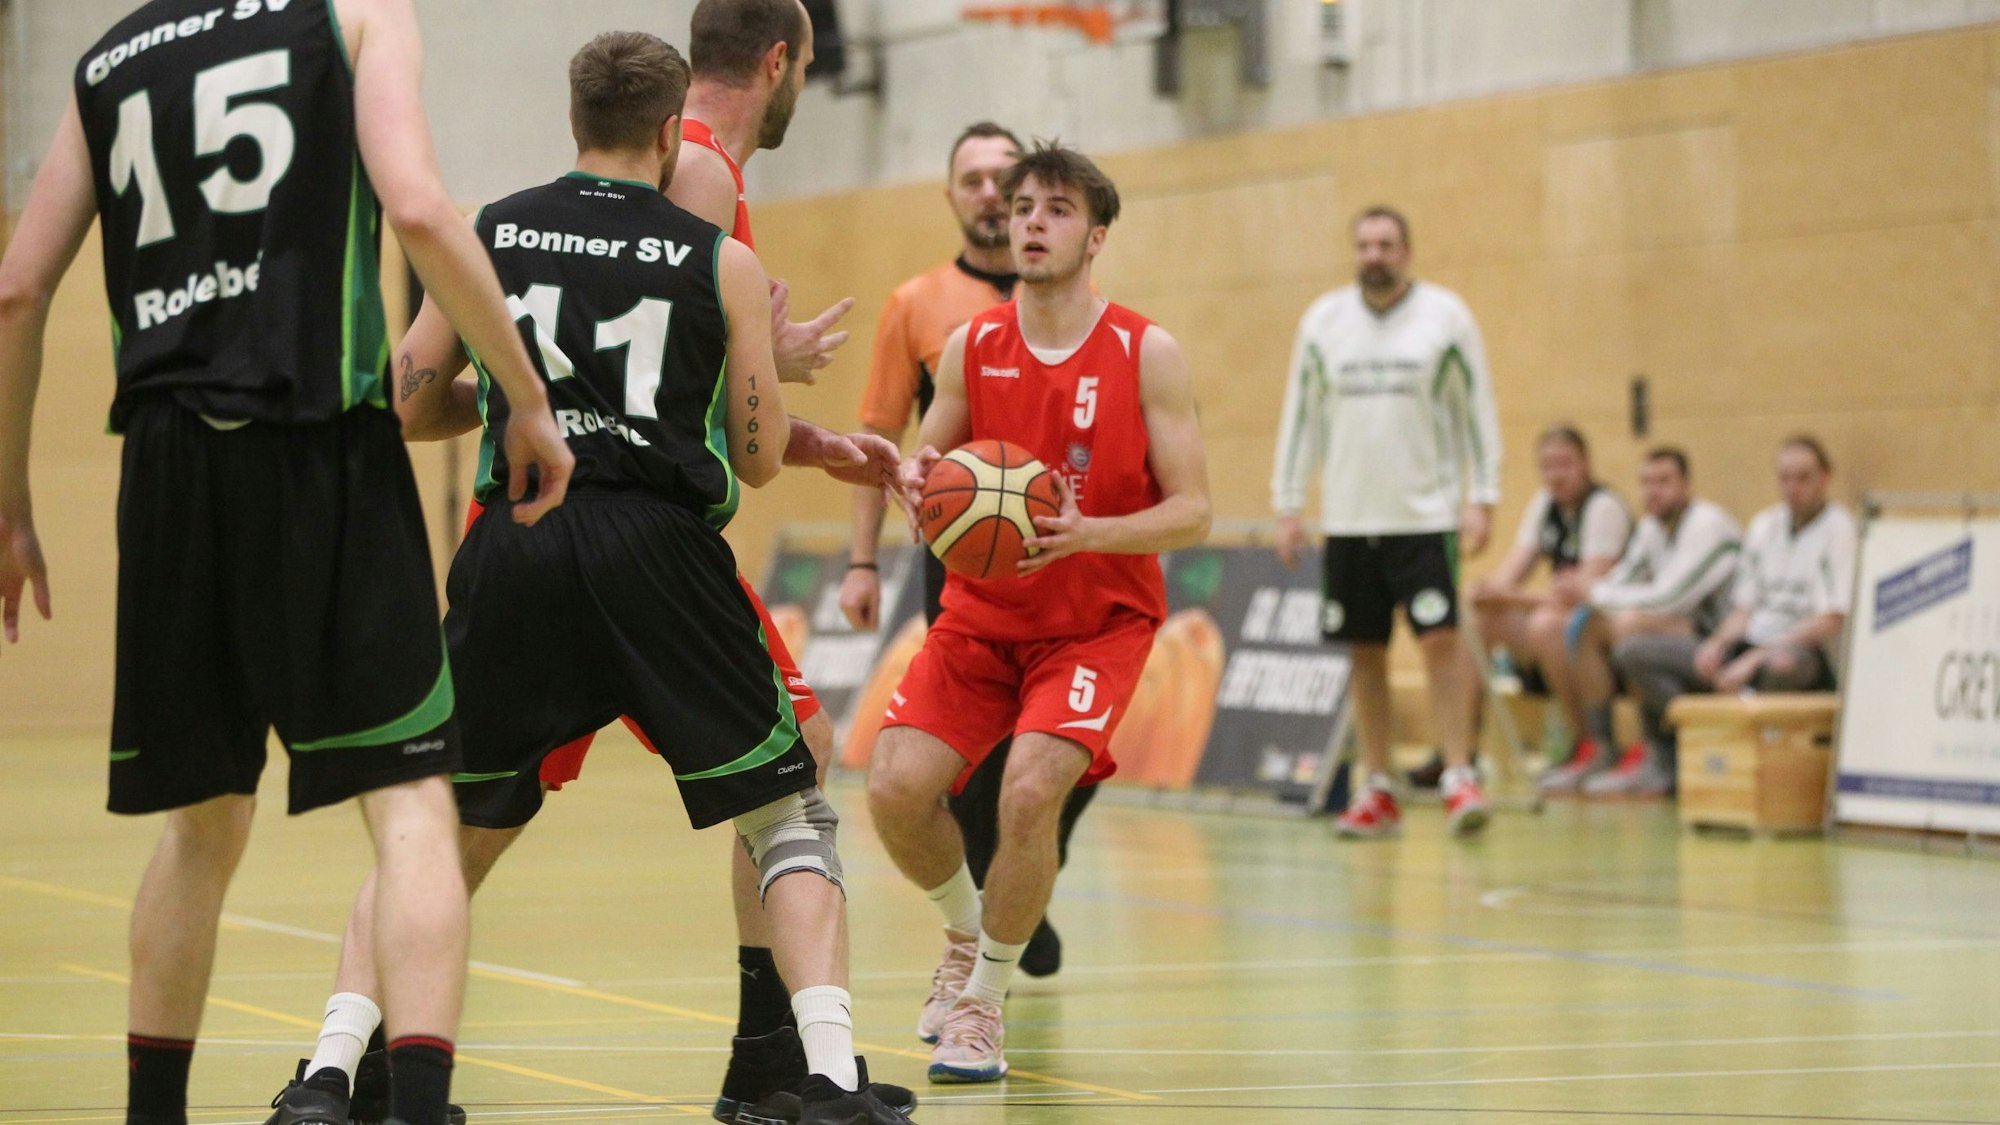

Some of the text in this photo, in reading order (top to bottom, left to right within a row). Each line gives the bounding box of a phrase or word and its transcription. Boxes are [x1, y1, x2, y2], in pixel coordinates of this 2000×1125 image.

[109, 48, 296, 249] 15
[493, 222, 694, 268] Bonner SV
[133, 249, 264, 332] Rolebe
[504, 282, 674, 422] 11
[746, 374, 759, 456] 1966
[1072, 376, 1099, 430] 5
[1068, 664, 1098, 713] 5
